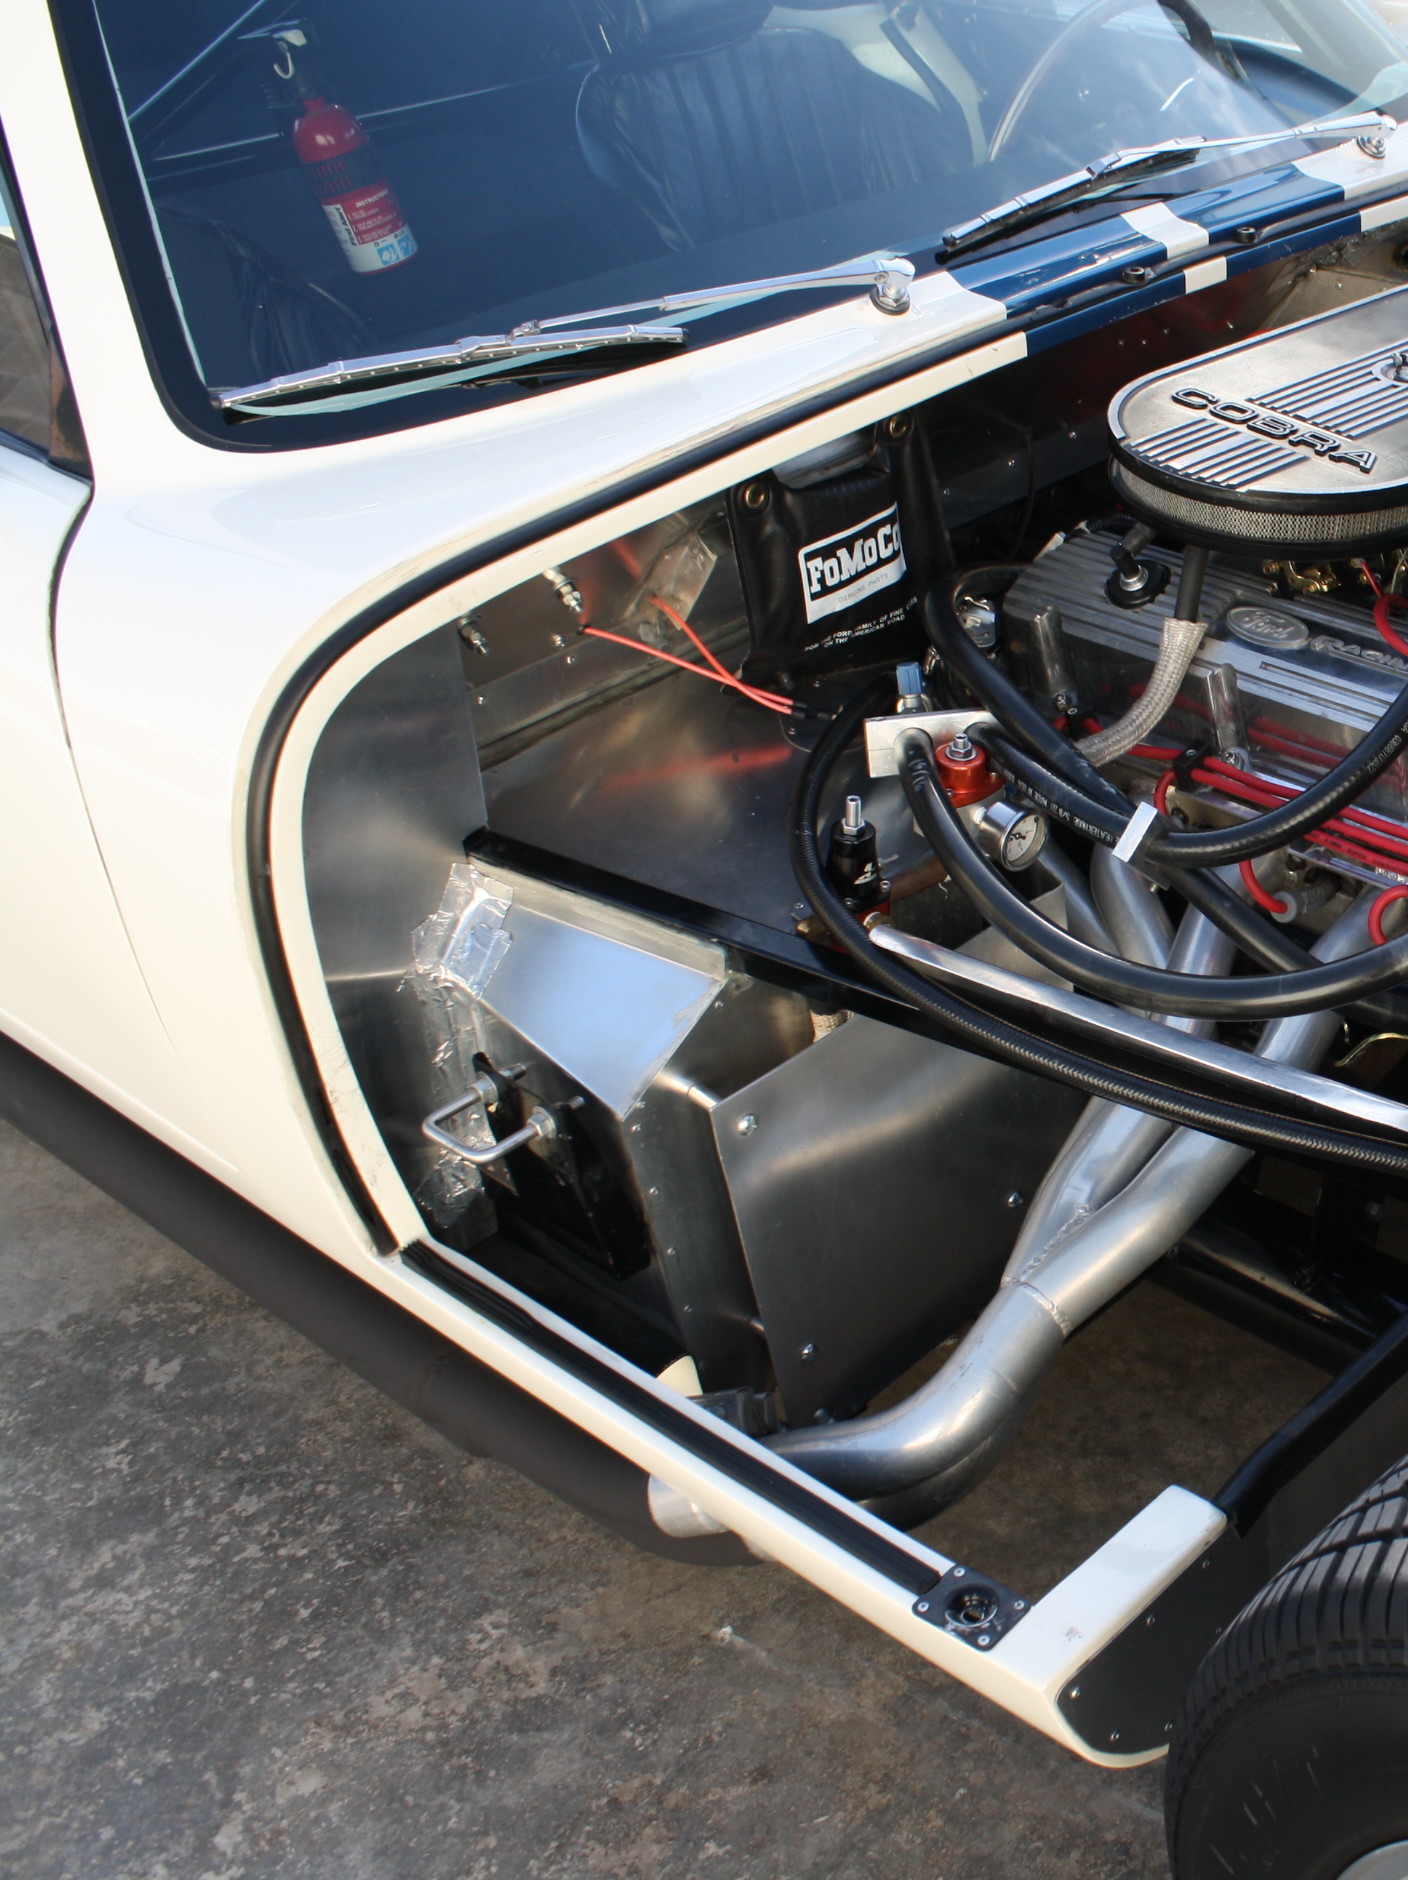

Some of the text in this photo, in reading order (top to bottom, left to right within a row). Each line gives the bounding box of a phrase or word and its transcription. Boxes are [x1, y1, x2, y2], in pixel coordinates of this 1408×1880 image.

[1171, 387, 1378, 474] COBRA
[807, 522, 900, 594] FoMoCo
[868, 573, 889, 587] PARTS
[833, 630, 853, 639] FORD
[879, 614, 888, 623] OF
[889, 608, 904, 618] FINE
[1243, 610, 1295, 639] Ford
[823, 641, 834, 649] ON
